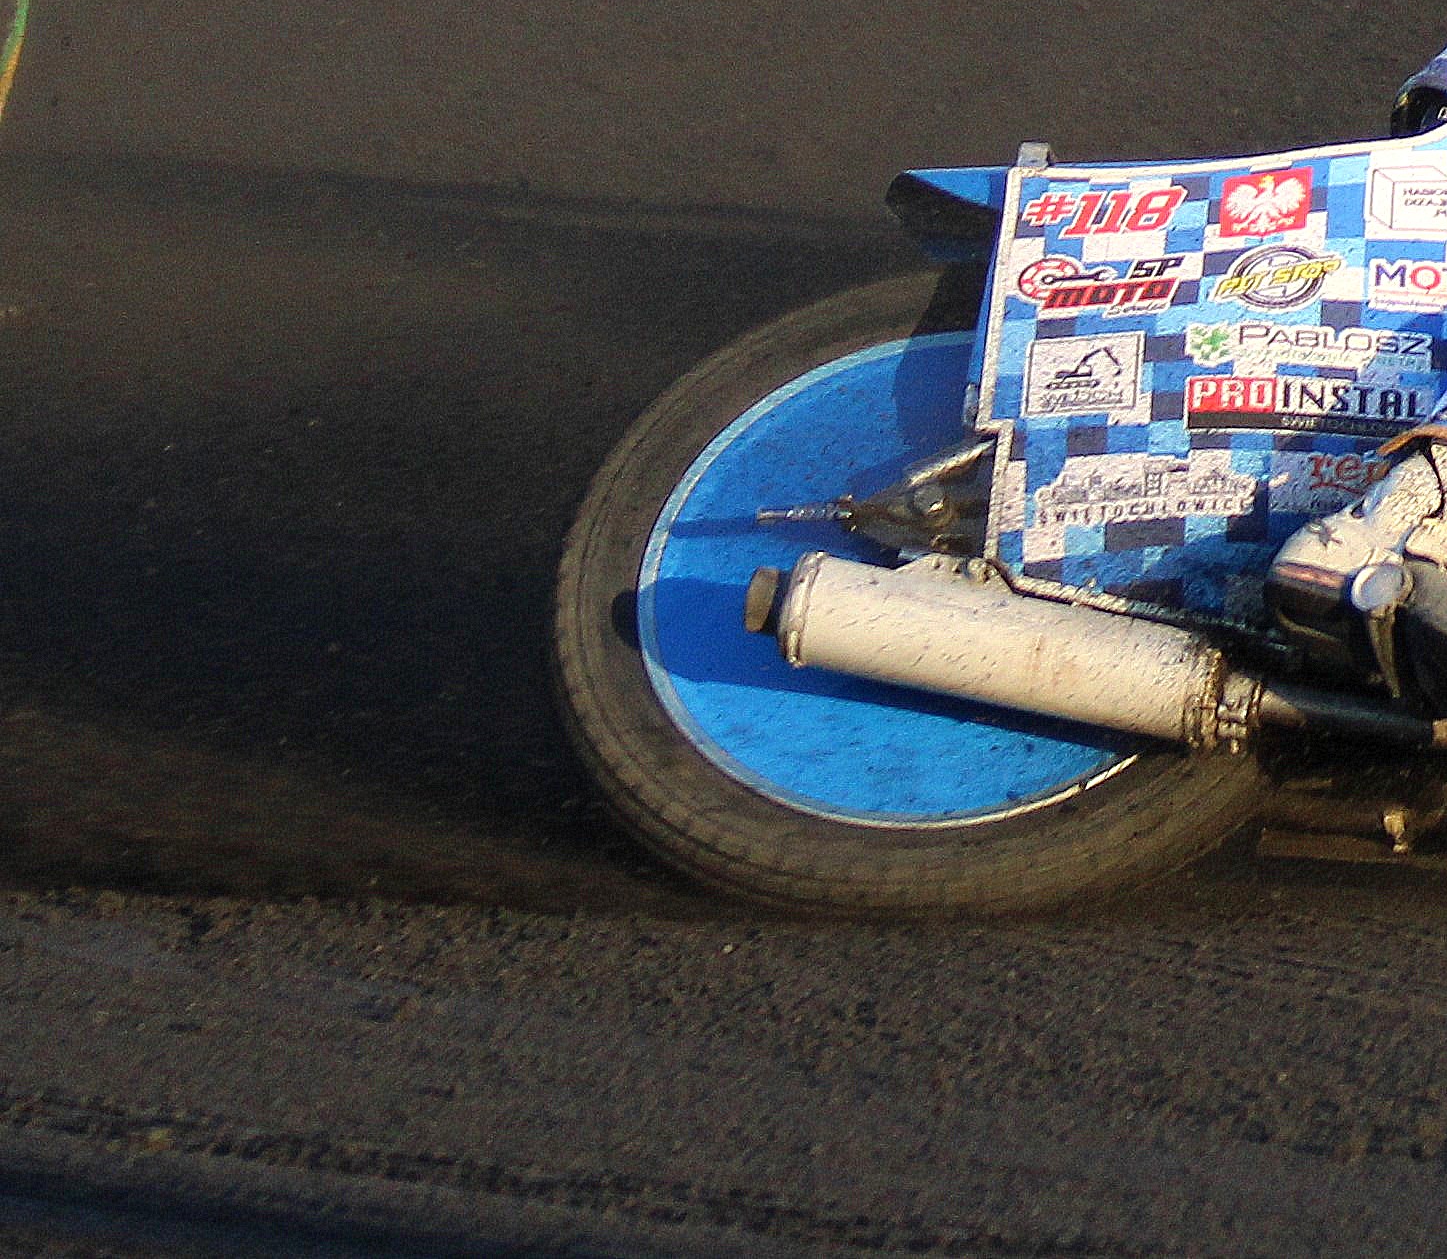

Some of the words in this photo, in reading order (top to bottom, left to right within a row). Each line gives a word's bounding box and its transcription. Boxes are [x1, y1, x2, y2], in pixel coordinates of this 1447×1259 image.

[1023, 186, 1186, 239] #118
[1129, 255, 1187, 280] SP
[1042, 277, 1179, 310] MOTO
[1238, 324, 1427, 356] PABLOSZ
[1191, 379, 1430, 420] PROINSTAL
